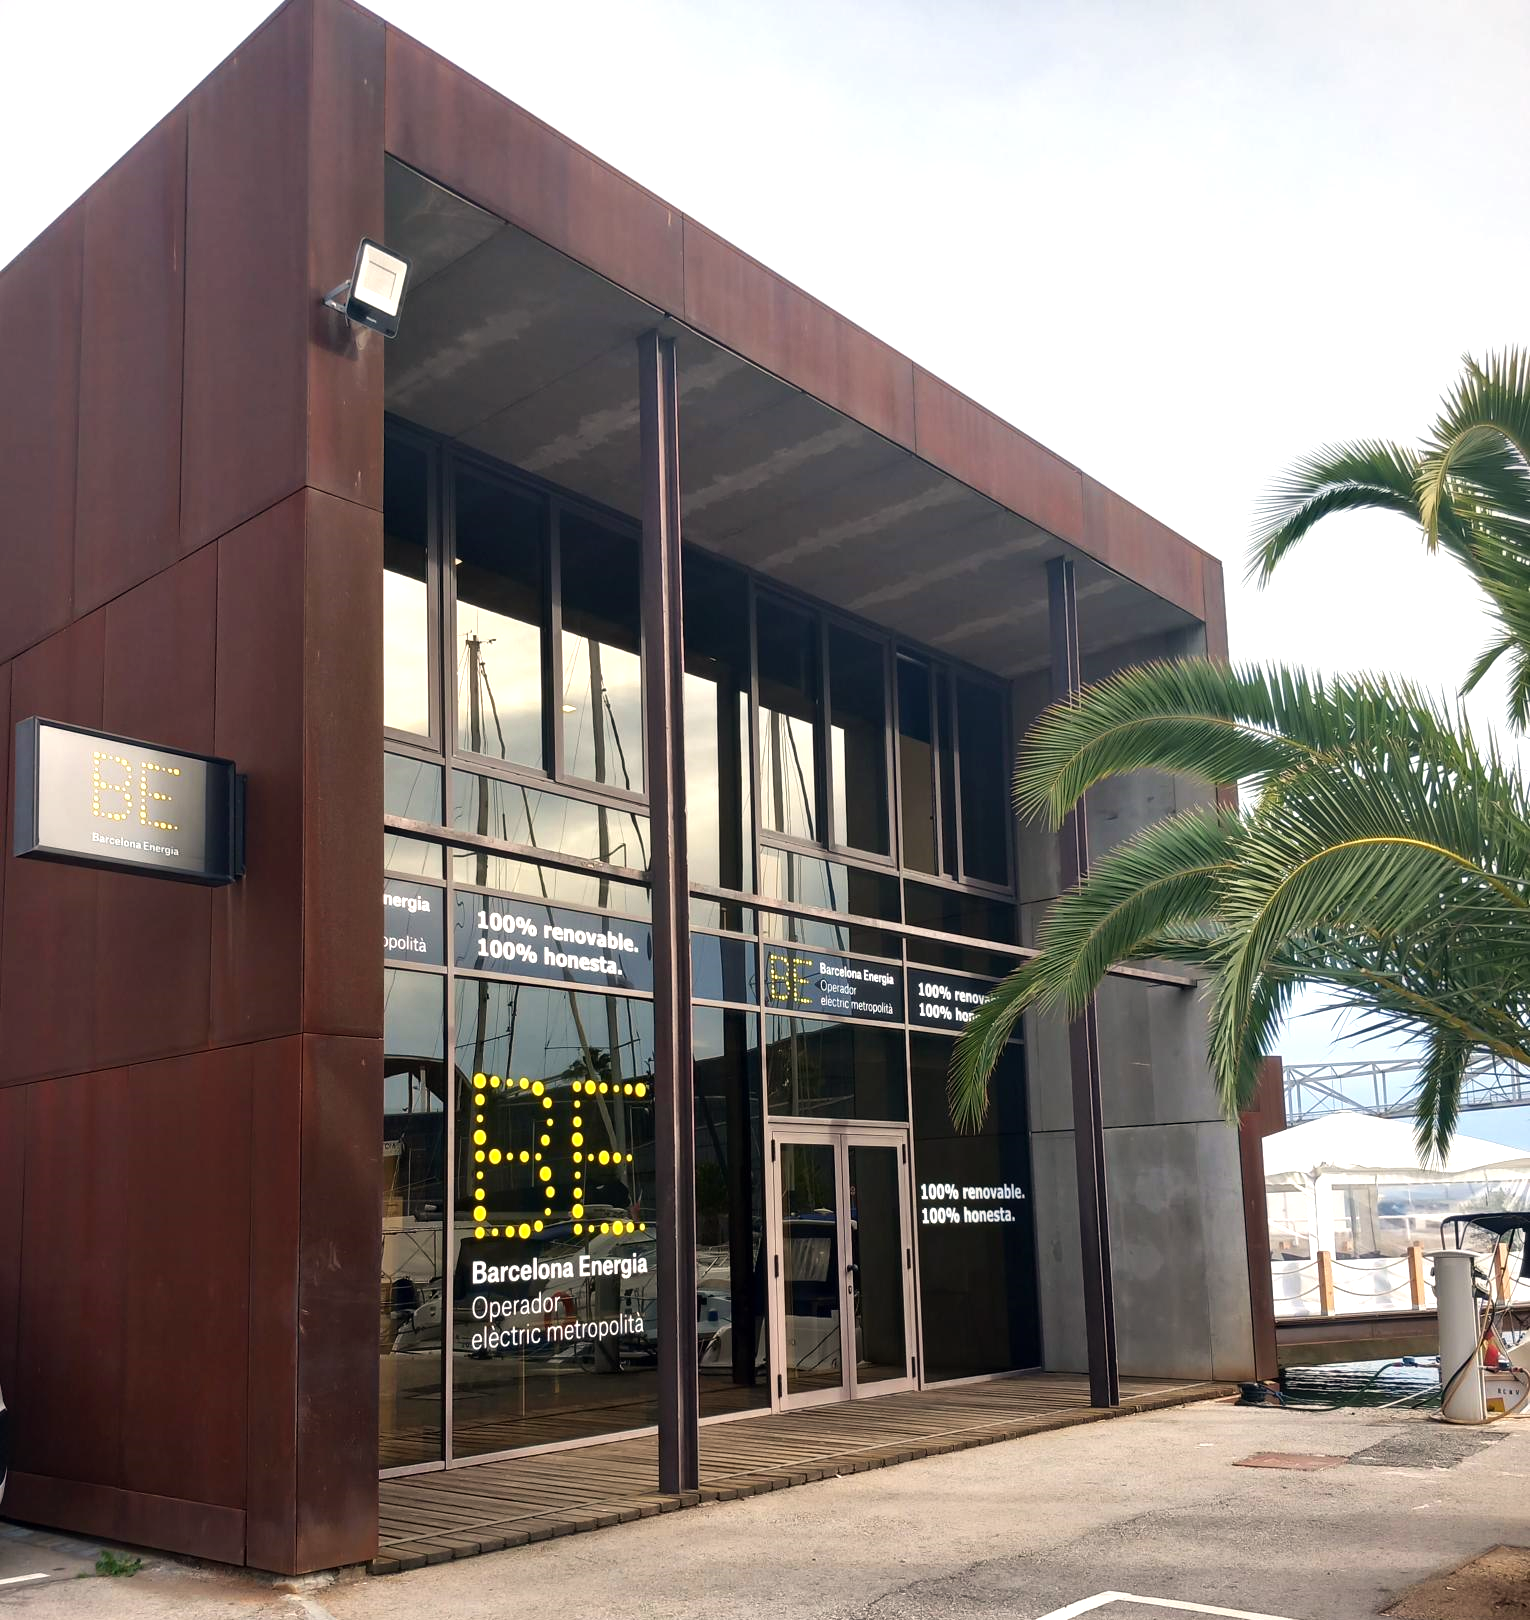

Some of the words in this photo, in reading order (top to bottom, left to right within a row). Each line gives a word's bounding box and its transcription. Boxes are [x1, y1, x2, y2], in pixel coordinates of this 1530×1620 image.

[92, 751, 180, 831] BE
[92, 832, 142, 850] Barcelona
[143, 841, 179, 857] Energia
[383, 893, 431, 913] nergia
[383, 935, 427, 953] opolità
[477, 911, 538, 937] 100%
[543, 923, 639, 953] renovable.
[477, 938, 538, 964] 100%
[543, 947, 623, 976] honesta.
[770, 954, 813, 1004] BE
[819, 962, 863, 979] Barcelona
[863, 969, 895, 987] Energia
[820, 979, 857, 996] Operador
[918, 982, 952, 1001] 100%
[954, 990, 1000, 1005] renov
[820, 995, 850, 1009] elèctric
[850, 1000, 894, 1015] metropolità
[919, 1002, 953, 1020] 100%
[473, 1072, 647, 1239] BE
[920, 1183, 960, 1200] 100%
[962, 1183, 1026, 1200] renovable.
[921, 1207, 961, 1225] 100%
[963, 1206, 1016, 1223] honesta.
[471, 1257, 575, 1285] Barcelona
[578, 1252, 649, 1280] Energia
[471, 1291, 561, 1325] Operador
[471, 1324, 542, 1351] elèctric
[546, 1312, 645, 1342] metropolità
